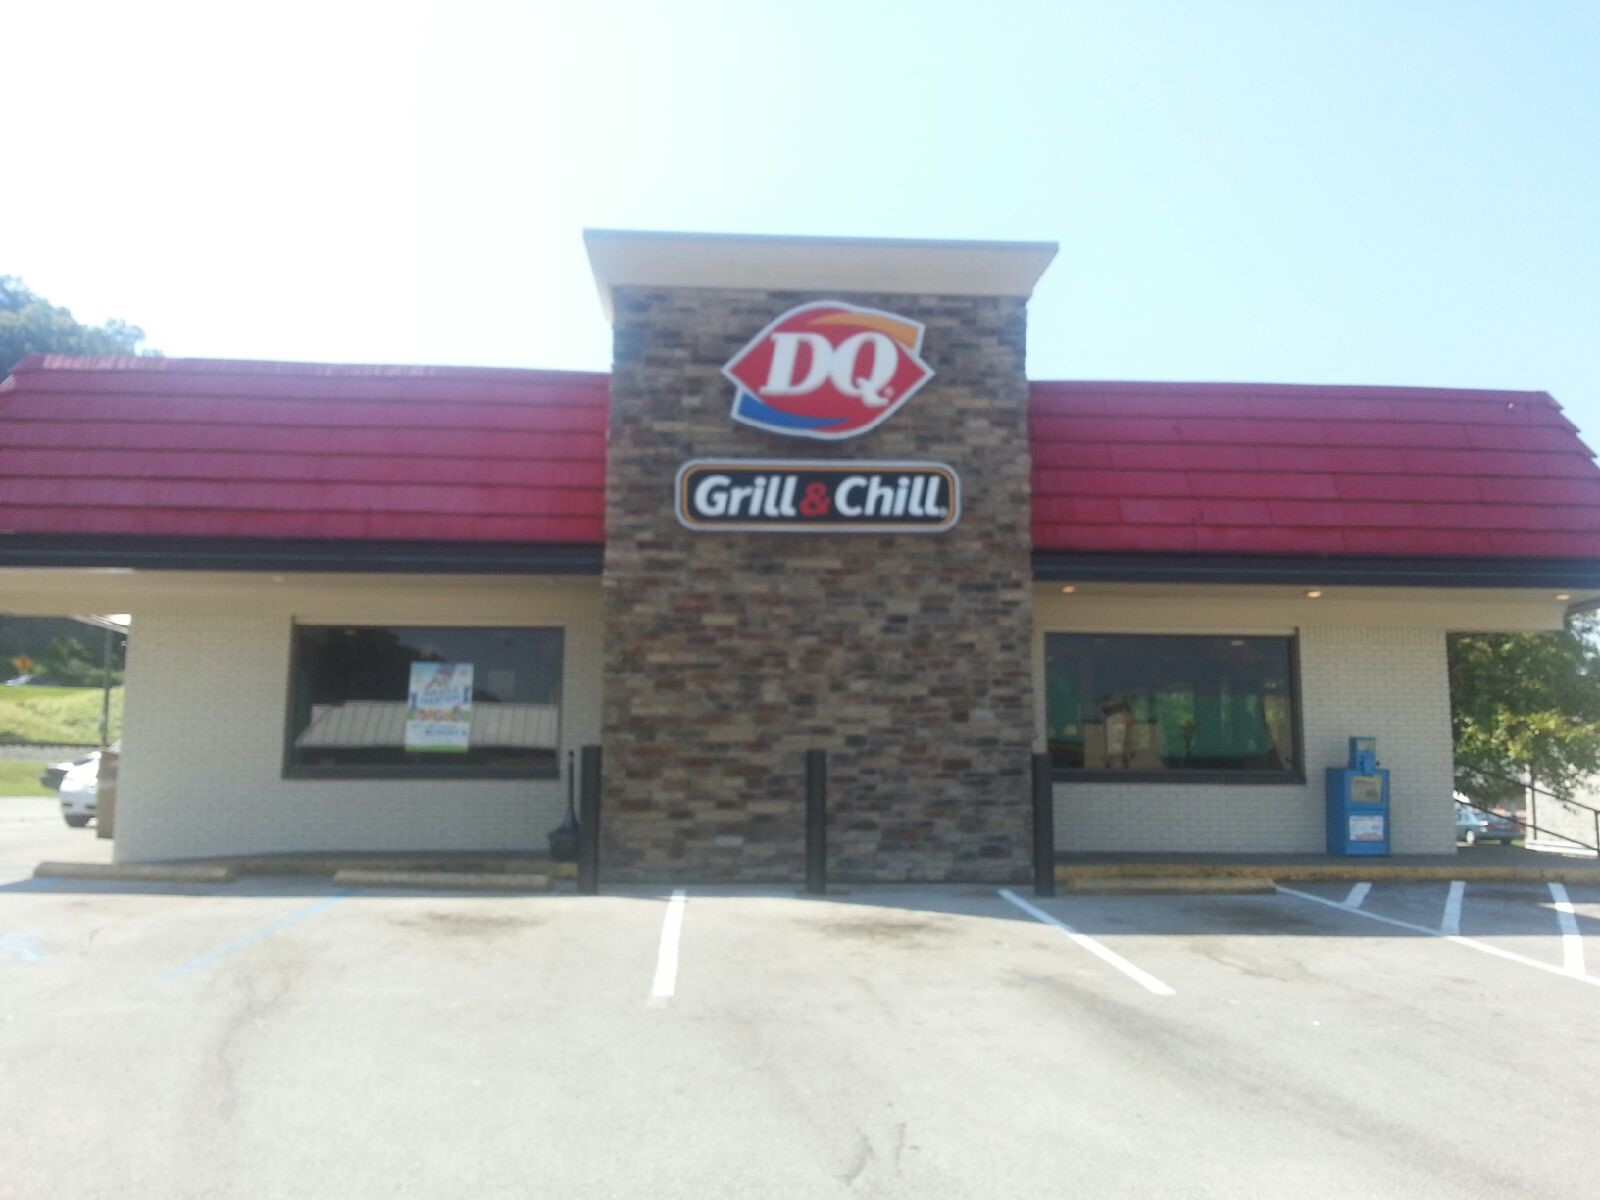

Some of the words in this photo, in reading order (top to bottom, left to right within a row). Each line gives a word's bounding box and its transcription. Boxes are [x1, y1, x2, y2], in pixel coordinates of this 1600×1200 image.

[759, 331, 898, 407] DQ
[694, 474, 798, 517] Grill
[800, 482, 830, 516] &
[834, 475, 941, 517] Chill
